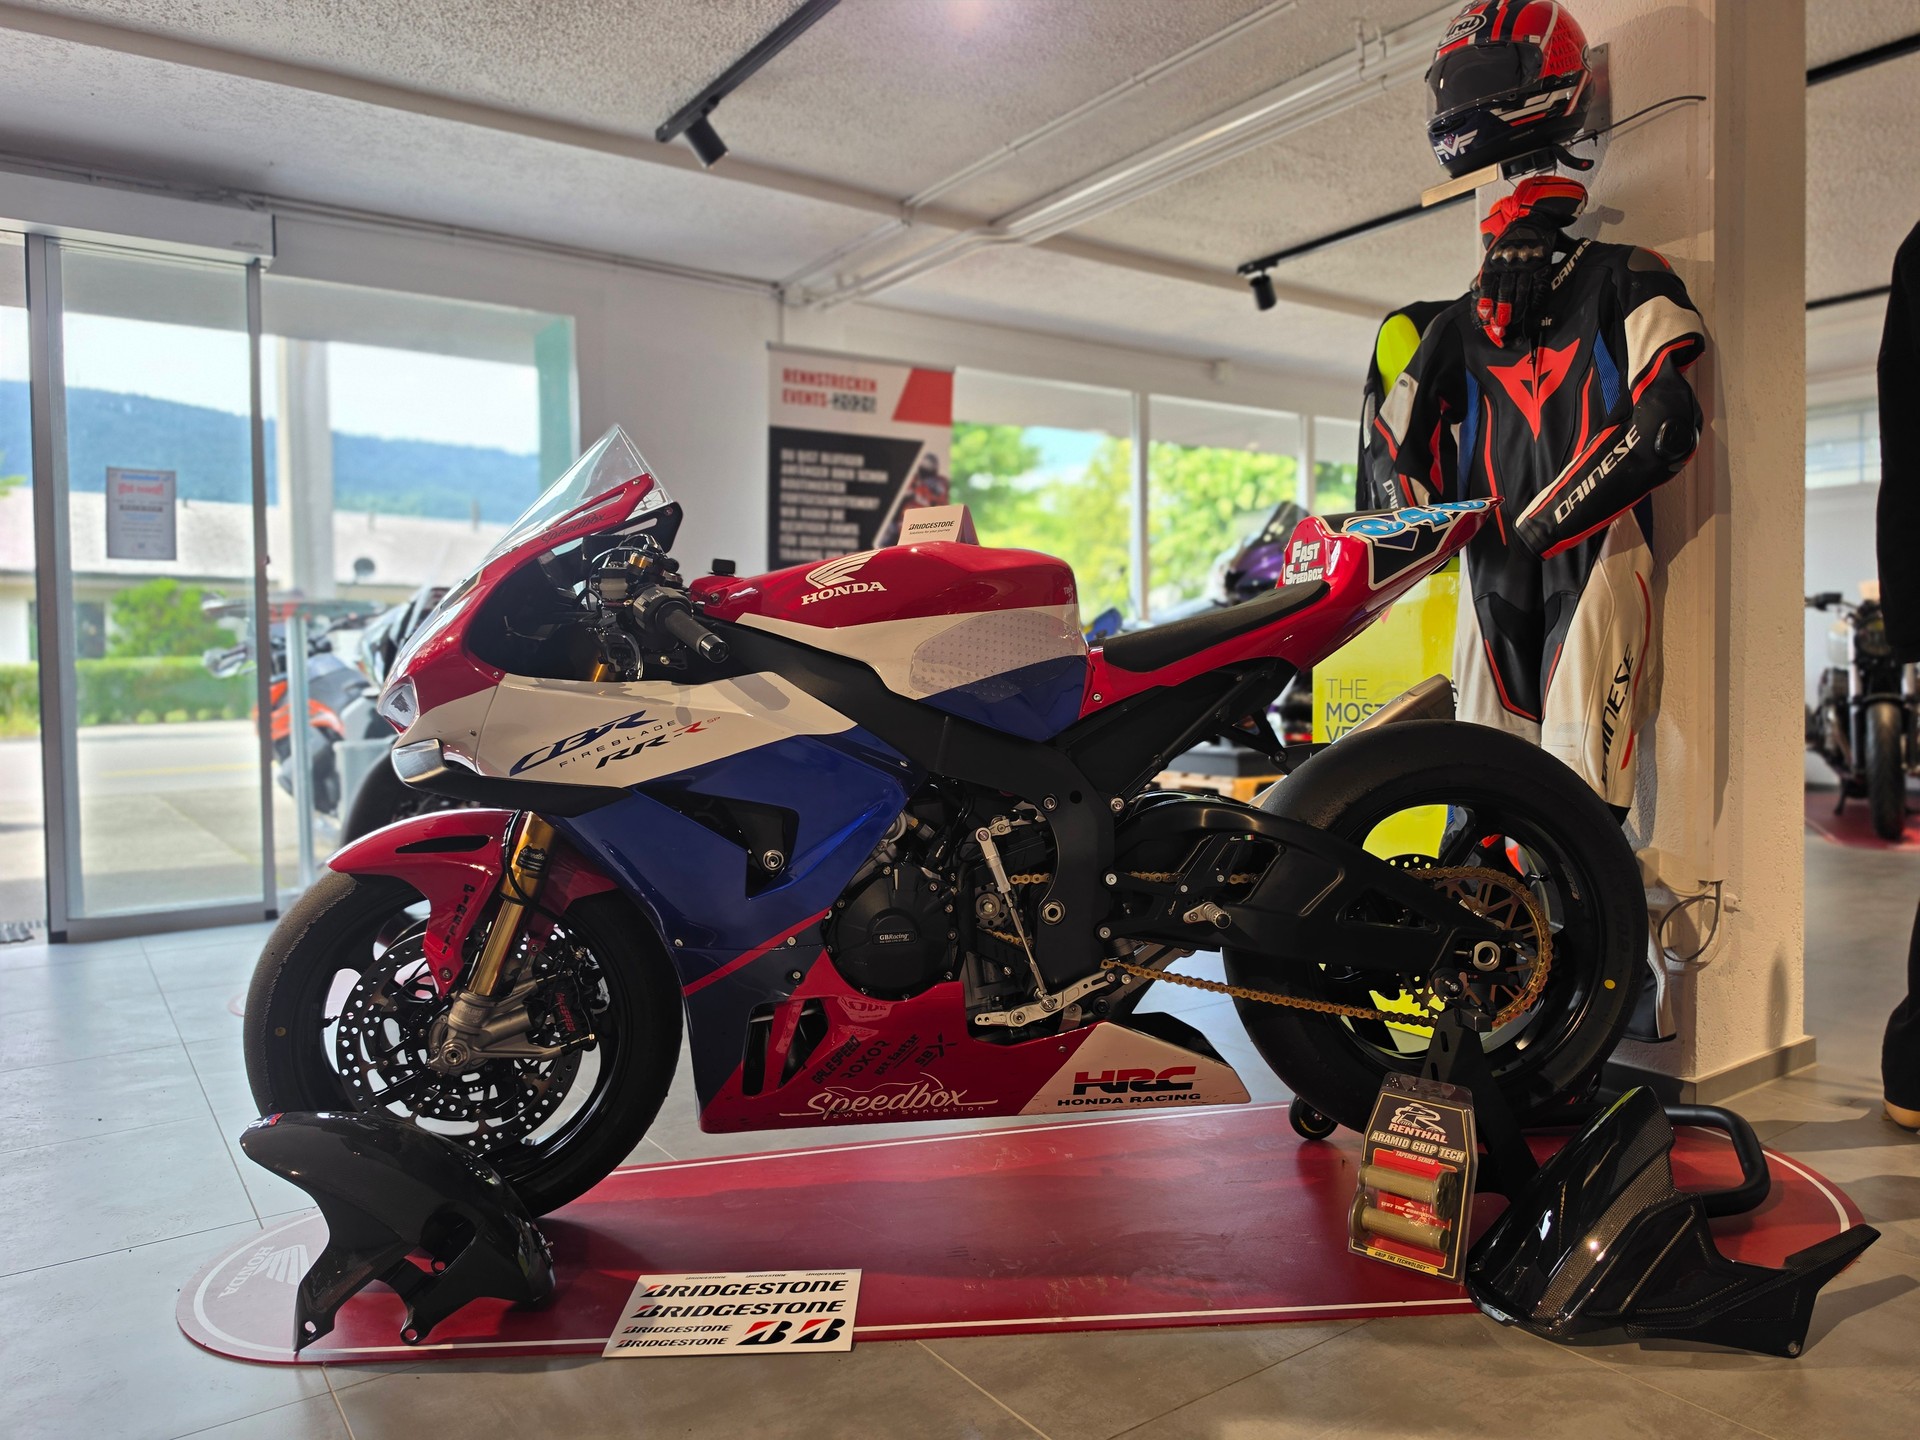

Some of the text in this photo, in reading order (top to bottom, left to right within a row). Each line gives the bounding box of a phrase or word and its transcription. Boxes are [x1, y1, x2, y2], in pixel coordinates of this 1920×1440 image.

[1551, 239, 1591, 290] DAINES
[1554, 424, 1640, 524] DAINESE
[1382, 479, 1399, 509] DAIN
[908, 520, 955, 531] BRIDGESTONE
[1291, 540, 1321, 564] FAST
[1301, 561, 1310, 571] BY
[801, 581, 887, 606] HONDA
[1326, 678, 1367, 700] THE
[509, 710, 659, 777] CBR
[559, 719, 676, 768] FIREBLADE
[1073, 1066, 1197, 1095] HRC
[805, 1083, 972, 1120] Speedbox
[901, 1105, 985, 1115] Sensation
[1057, 1093, 1201, 1106] HONDA RACING
[1388, 1122, 1448, 1144] RENTHAL
[1369, 1130, 1466, 1163] ARAMID GRIP TECH
[1395, 1150, 1418, 1162] TAPERED
[217, 1245, 275, 1299] HONDA
[640, 1279, 849, 1298] BRIDGESTONE
[631, 1300, 847, 1319] BRIDGESTONE
[621, 1324, 733, 1334] BRIDGESTONE
[615, 1337, 729, 1349] BRIDGESTONE
